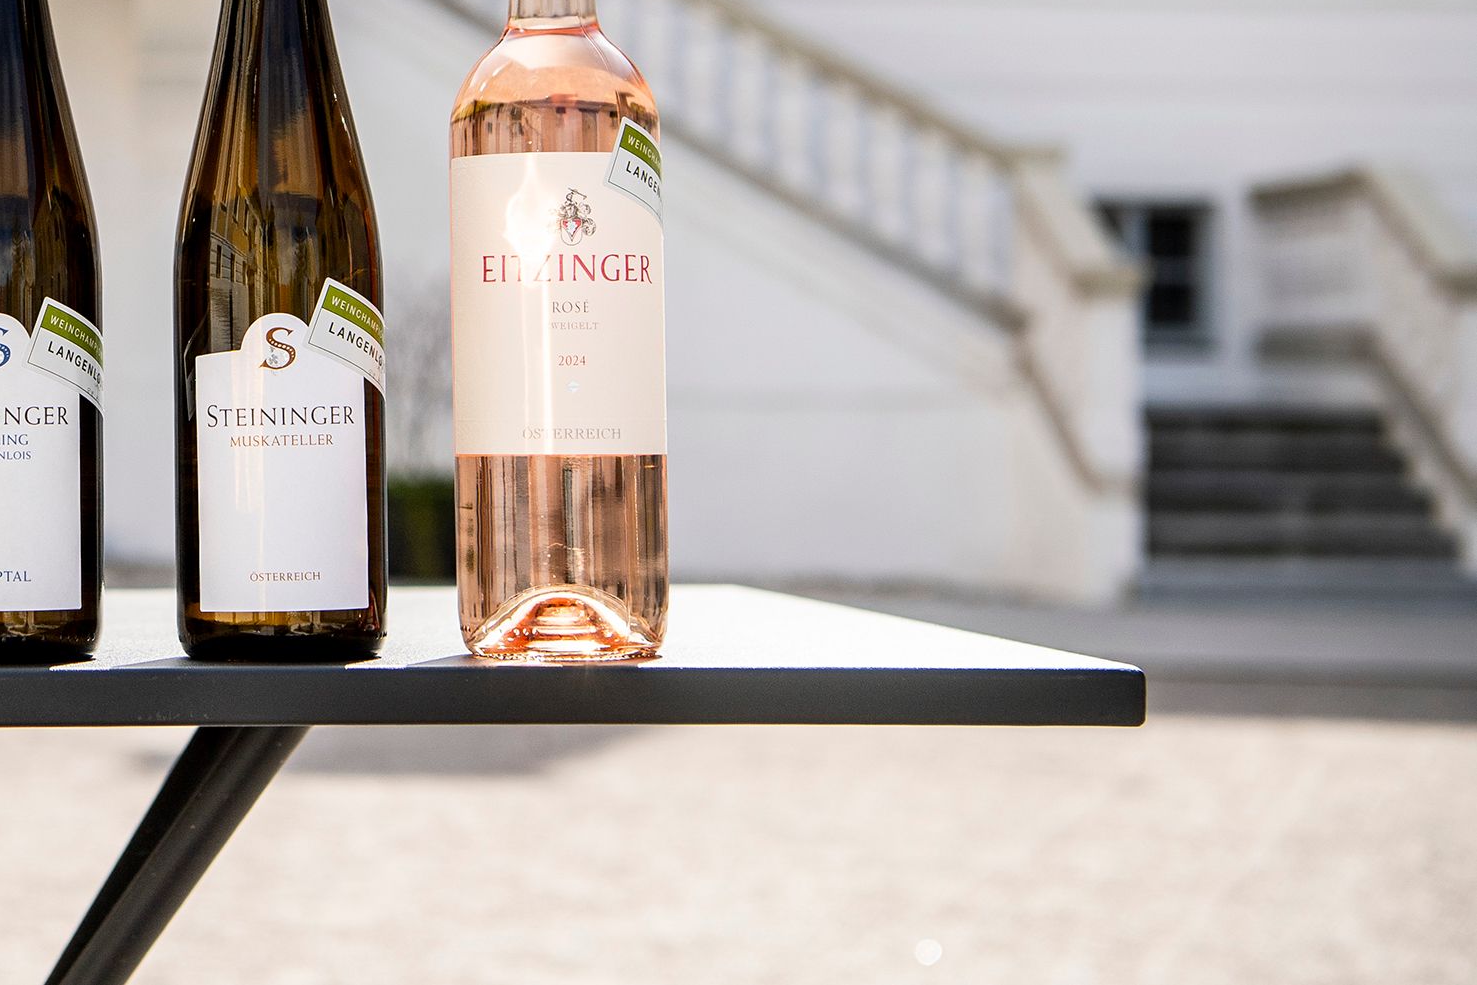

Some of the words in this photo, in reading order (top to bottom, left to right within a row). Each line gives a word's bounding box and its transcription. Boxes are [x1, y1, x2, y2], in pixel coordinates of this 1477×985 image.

[552, 300, 589, 313] ROSÉ
[550, 321, 600, 331] WEIGELT
[259, 327, 297, 370] S
[558, 355, 587, 366] 2024
[207, 404, 355, 428] STEININGER
[522, 426, 621, 439] ÖSERREICH
[230, 434, 334, 448] MUSKATELLER
[249, 571, 321, 582] ÖSTERREICH
